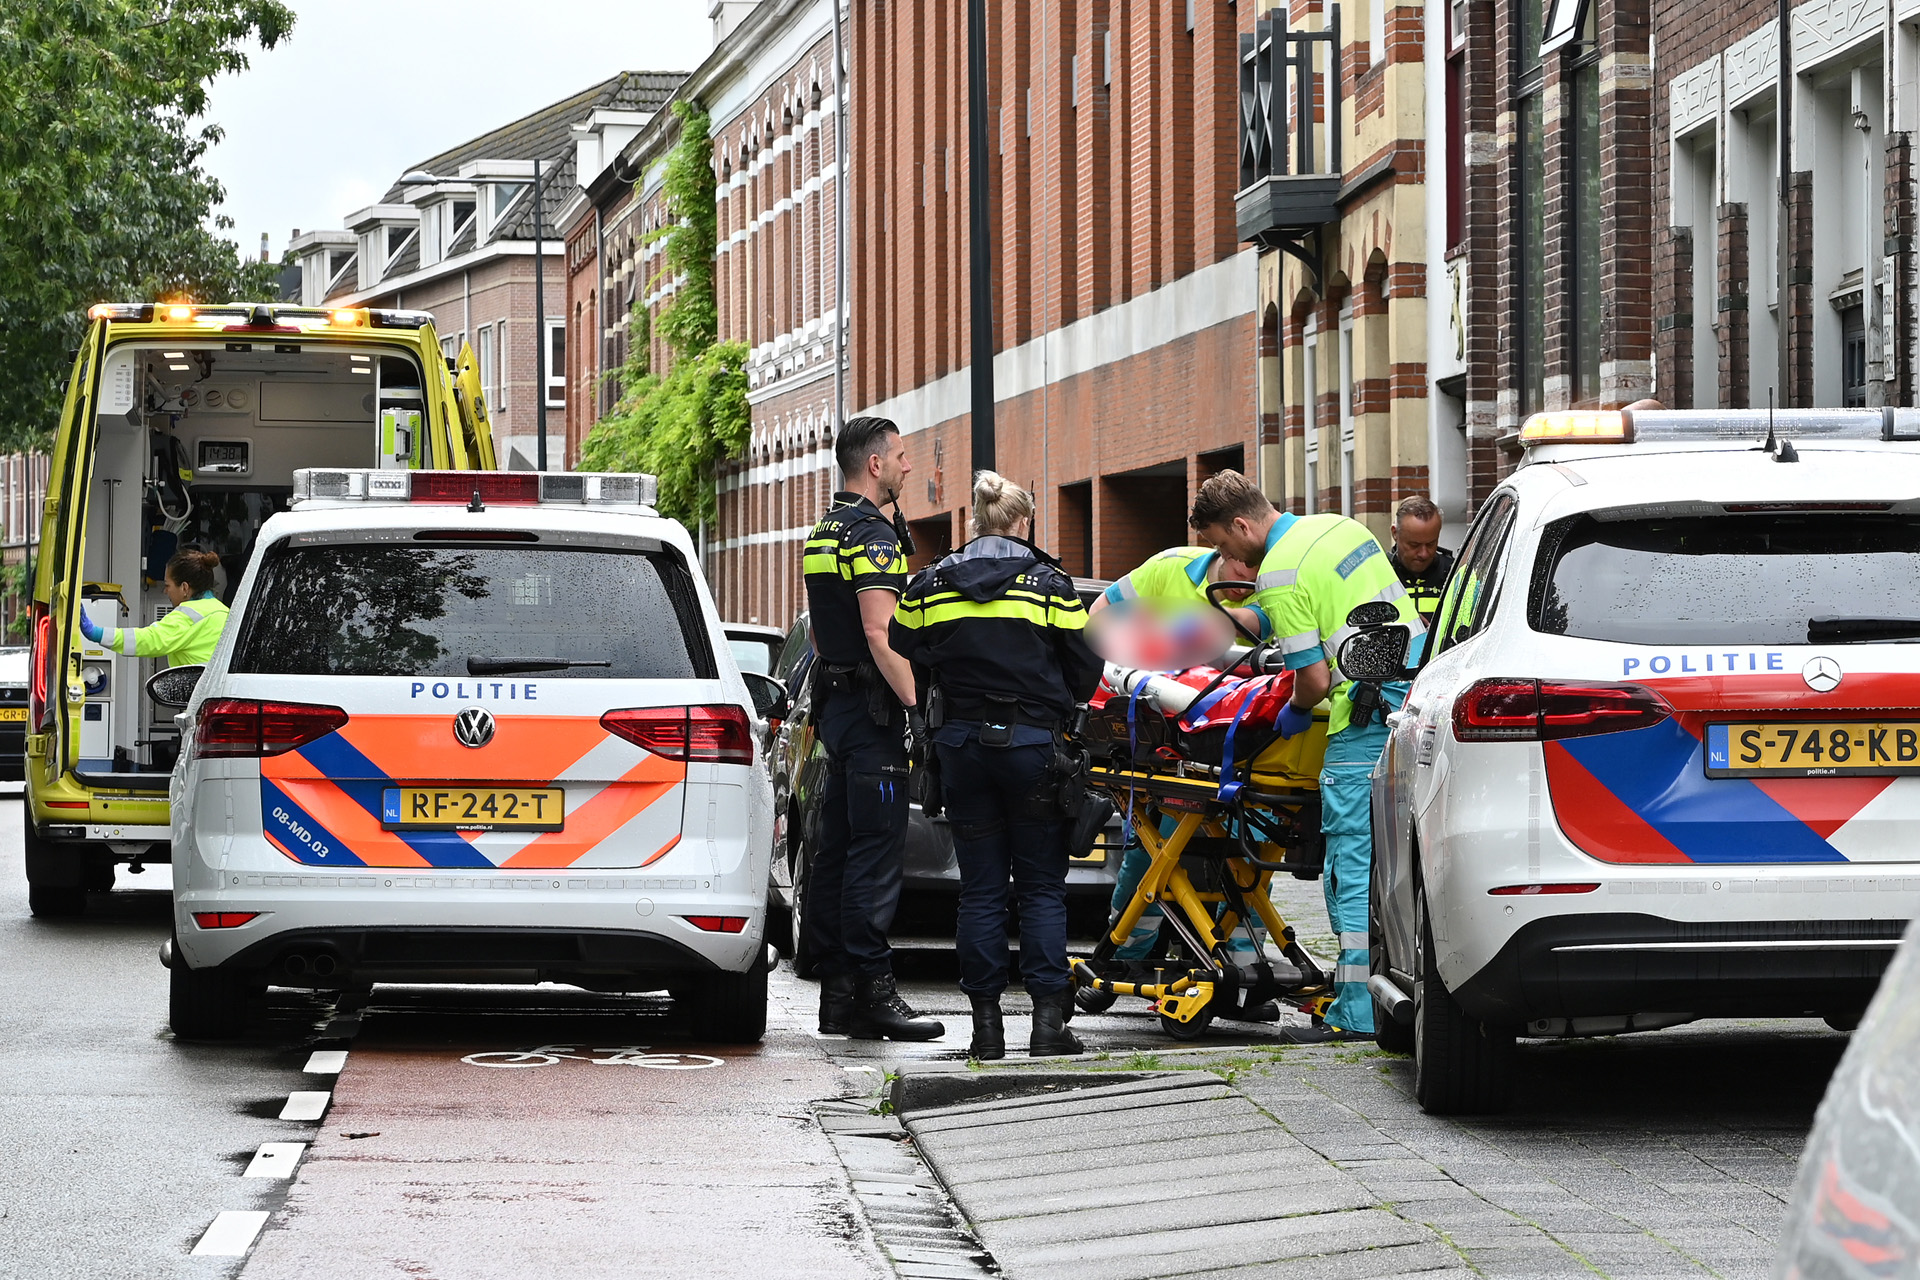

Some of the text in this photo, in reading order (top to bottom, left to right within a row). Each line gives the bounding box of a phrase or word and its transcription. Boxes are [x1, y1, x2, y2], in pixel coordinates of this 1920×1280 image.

[1339, 541, 1380, 578] AMBULANCE
[1622, 652, 1784, 676] POLITIE
[411, 682, 538, 700] POLITIE
[1710, 752, 1726, 762] NL
[1739, 729, 1919, 763] S-748-KB
[1806, 768, 1836, 776] politie.nl
[386, 809, 398, 817] NL
[412, 793, 548, 819] RF-242-T
[272, 806, 330, 858] 08-MD.03
